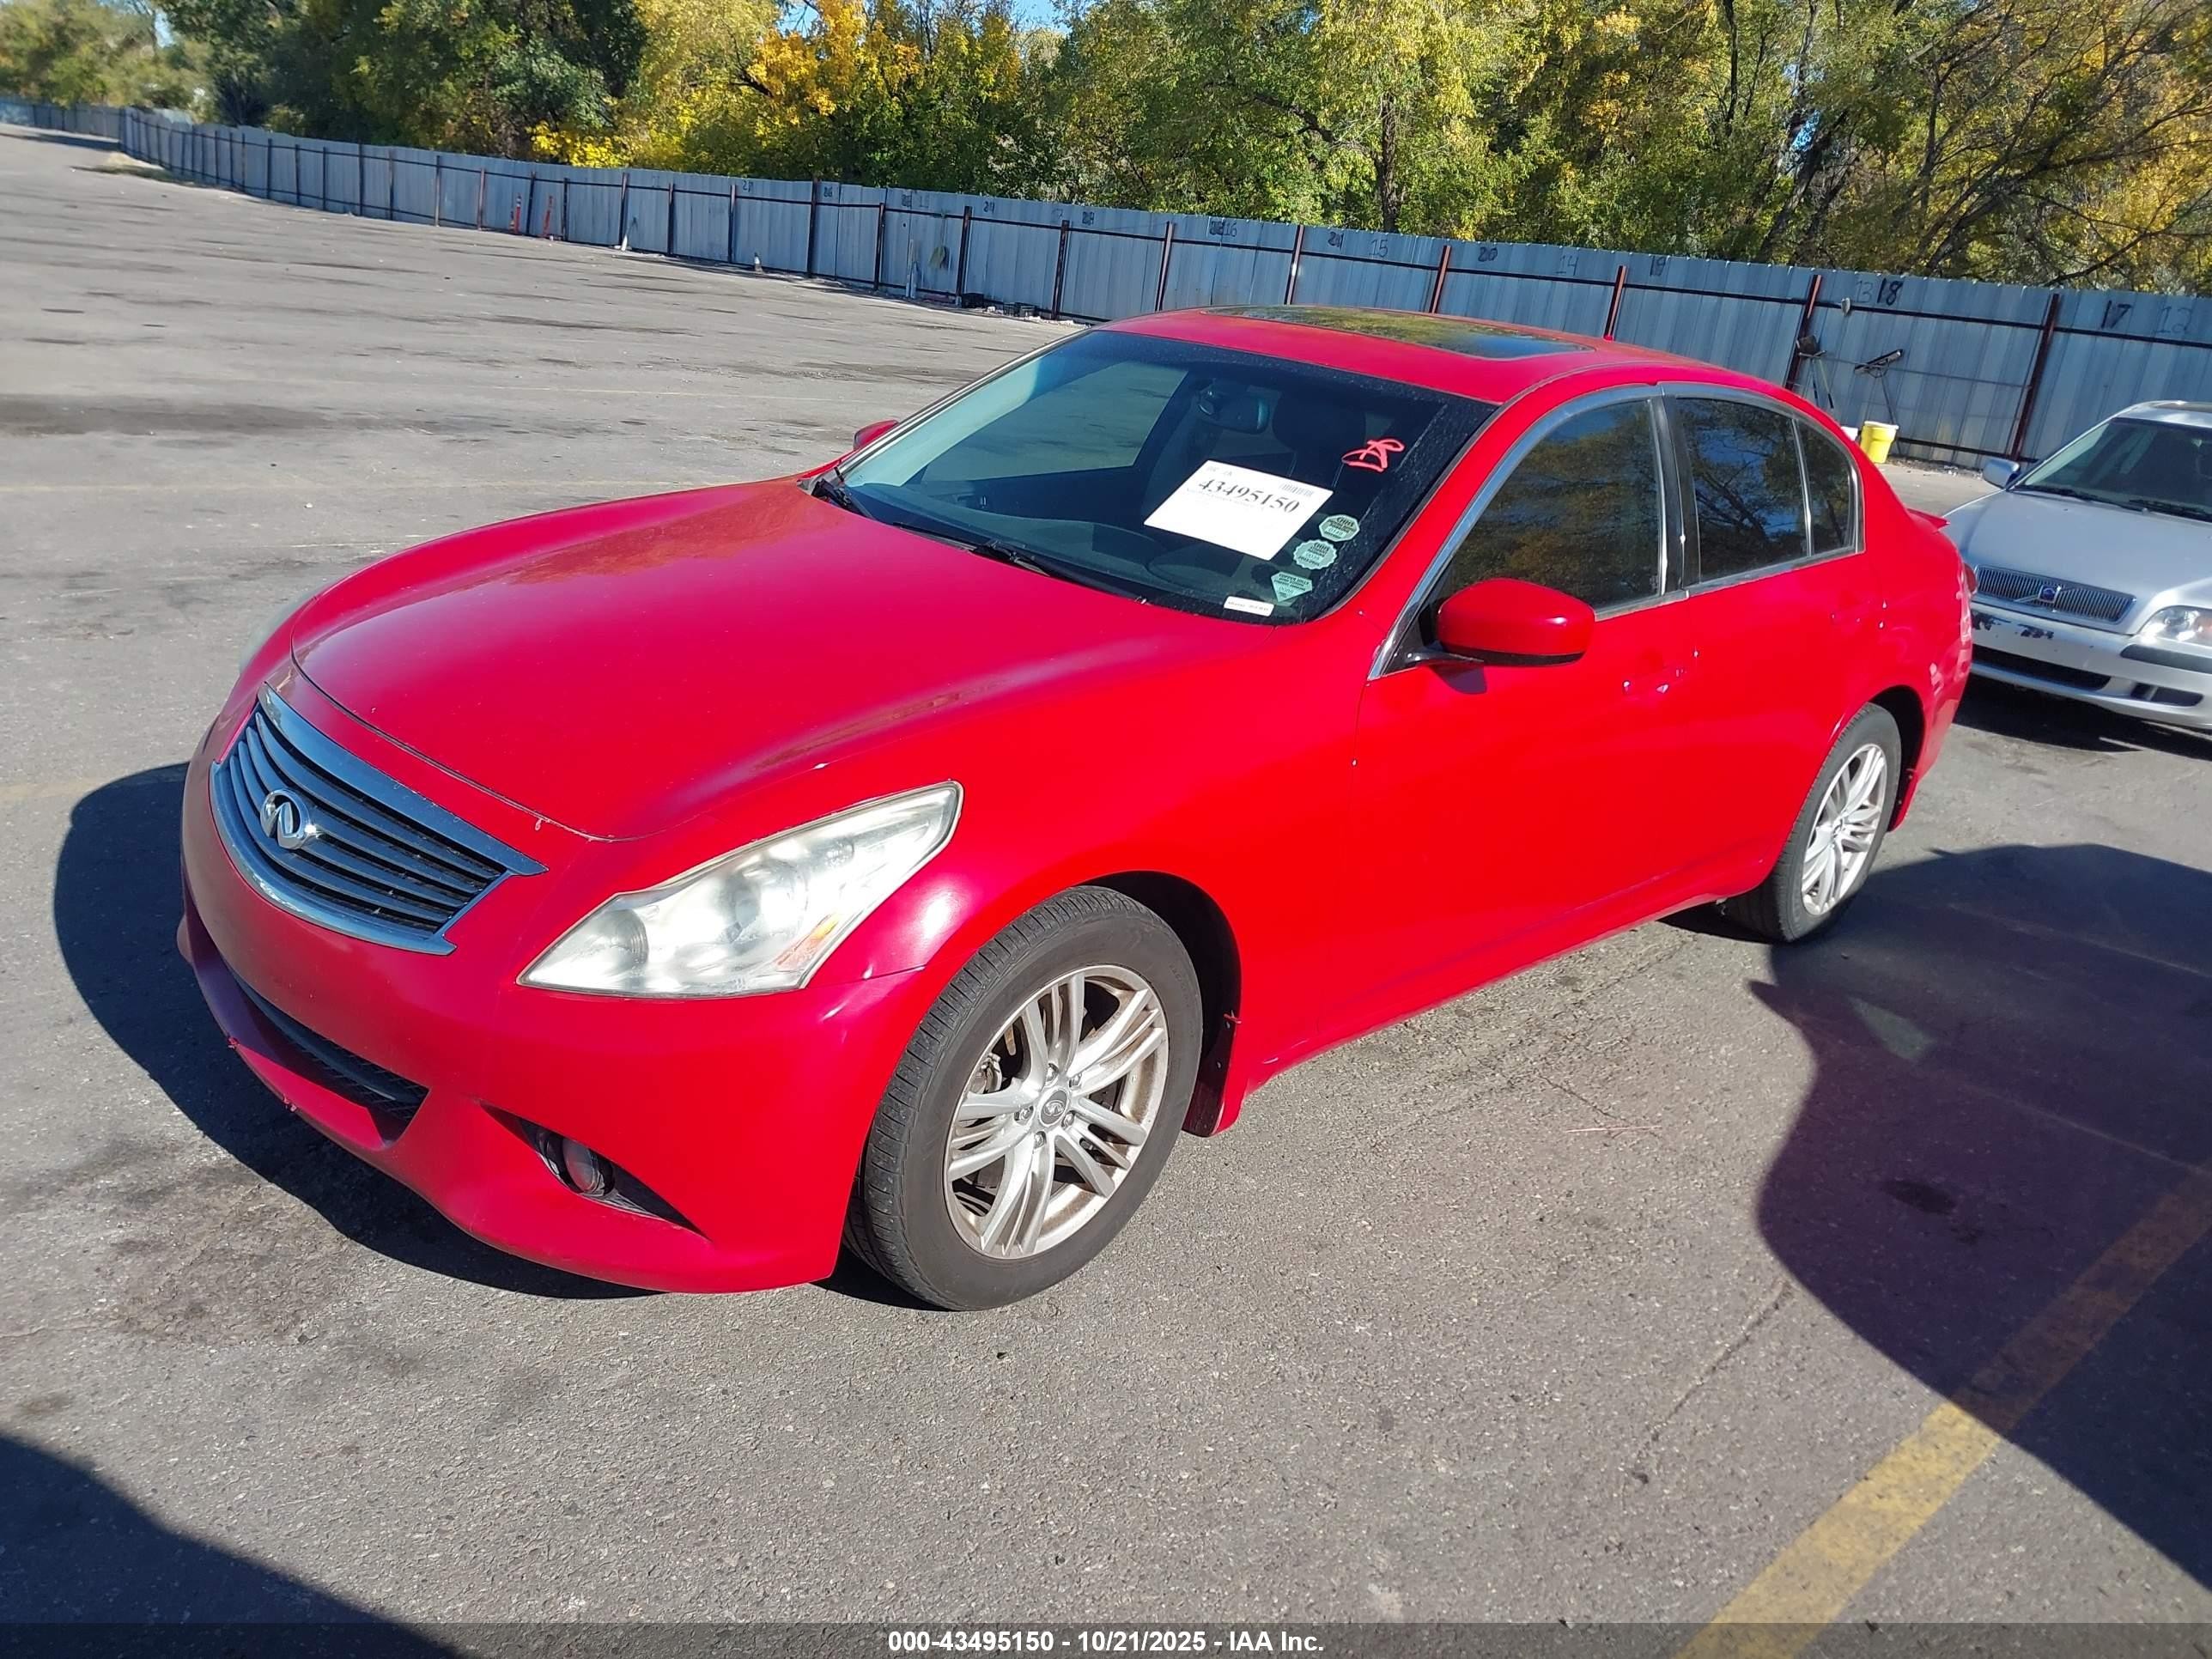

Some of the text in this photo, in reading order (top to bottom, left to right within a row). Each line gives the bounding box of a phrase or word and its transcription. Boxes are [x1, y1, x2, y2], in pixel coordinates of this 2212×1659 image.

[1368, 239, 1389, 258] 15
[1554, 255, 1579, 276] 14
[1856, 280, 1874, 304] 13
[1876, 277, 1905, 307] 18
[2100, 300, 2132, 330] 17
[2153, 305, 2193, 334] 12
[1199, 478, 1301, 514] 43495150
